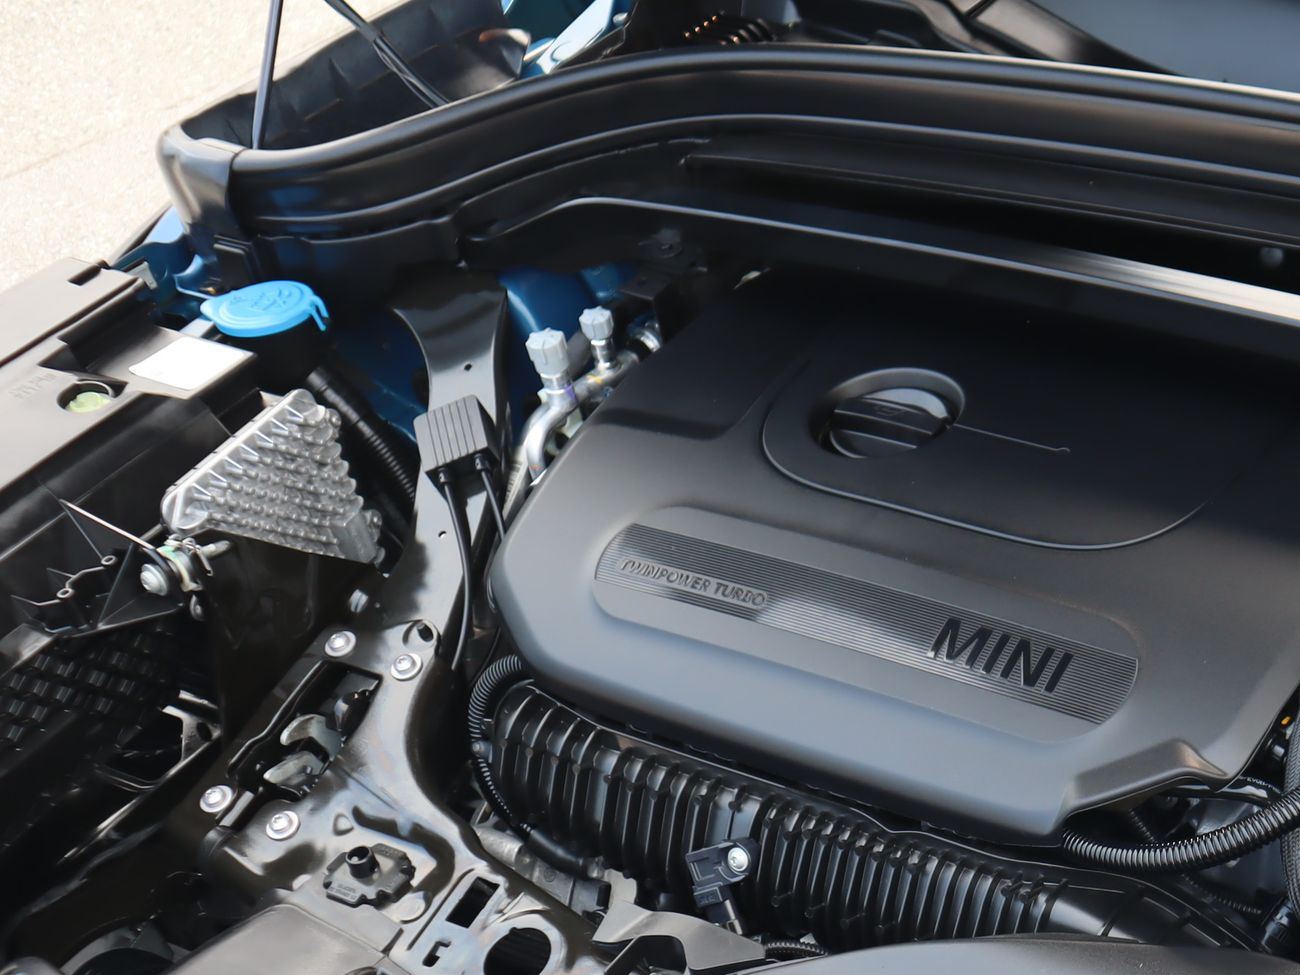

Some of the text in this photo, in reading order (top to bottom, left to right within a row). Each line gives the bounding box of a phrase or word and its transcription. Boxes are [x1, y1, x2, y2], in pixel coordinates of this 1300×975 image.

[620, 558, 766, 607] TWINPOWER TURBO
[926, 617, 1075, 694] MINI
